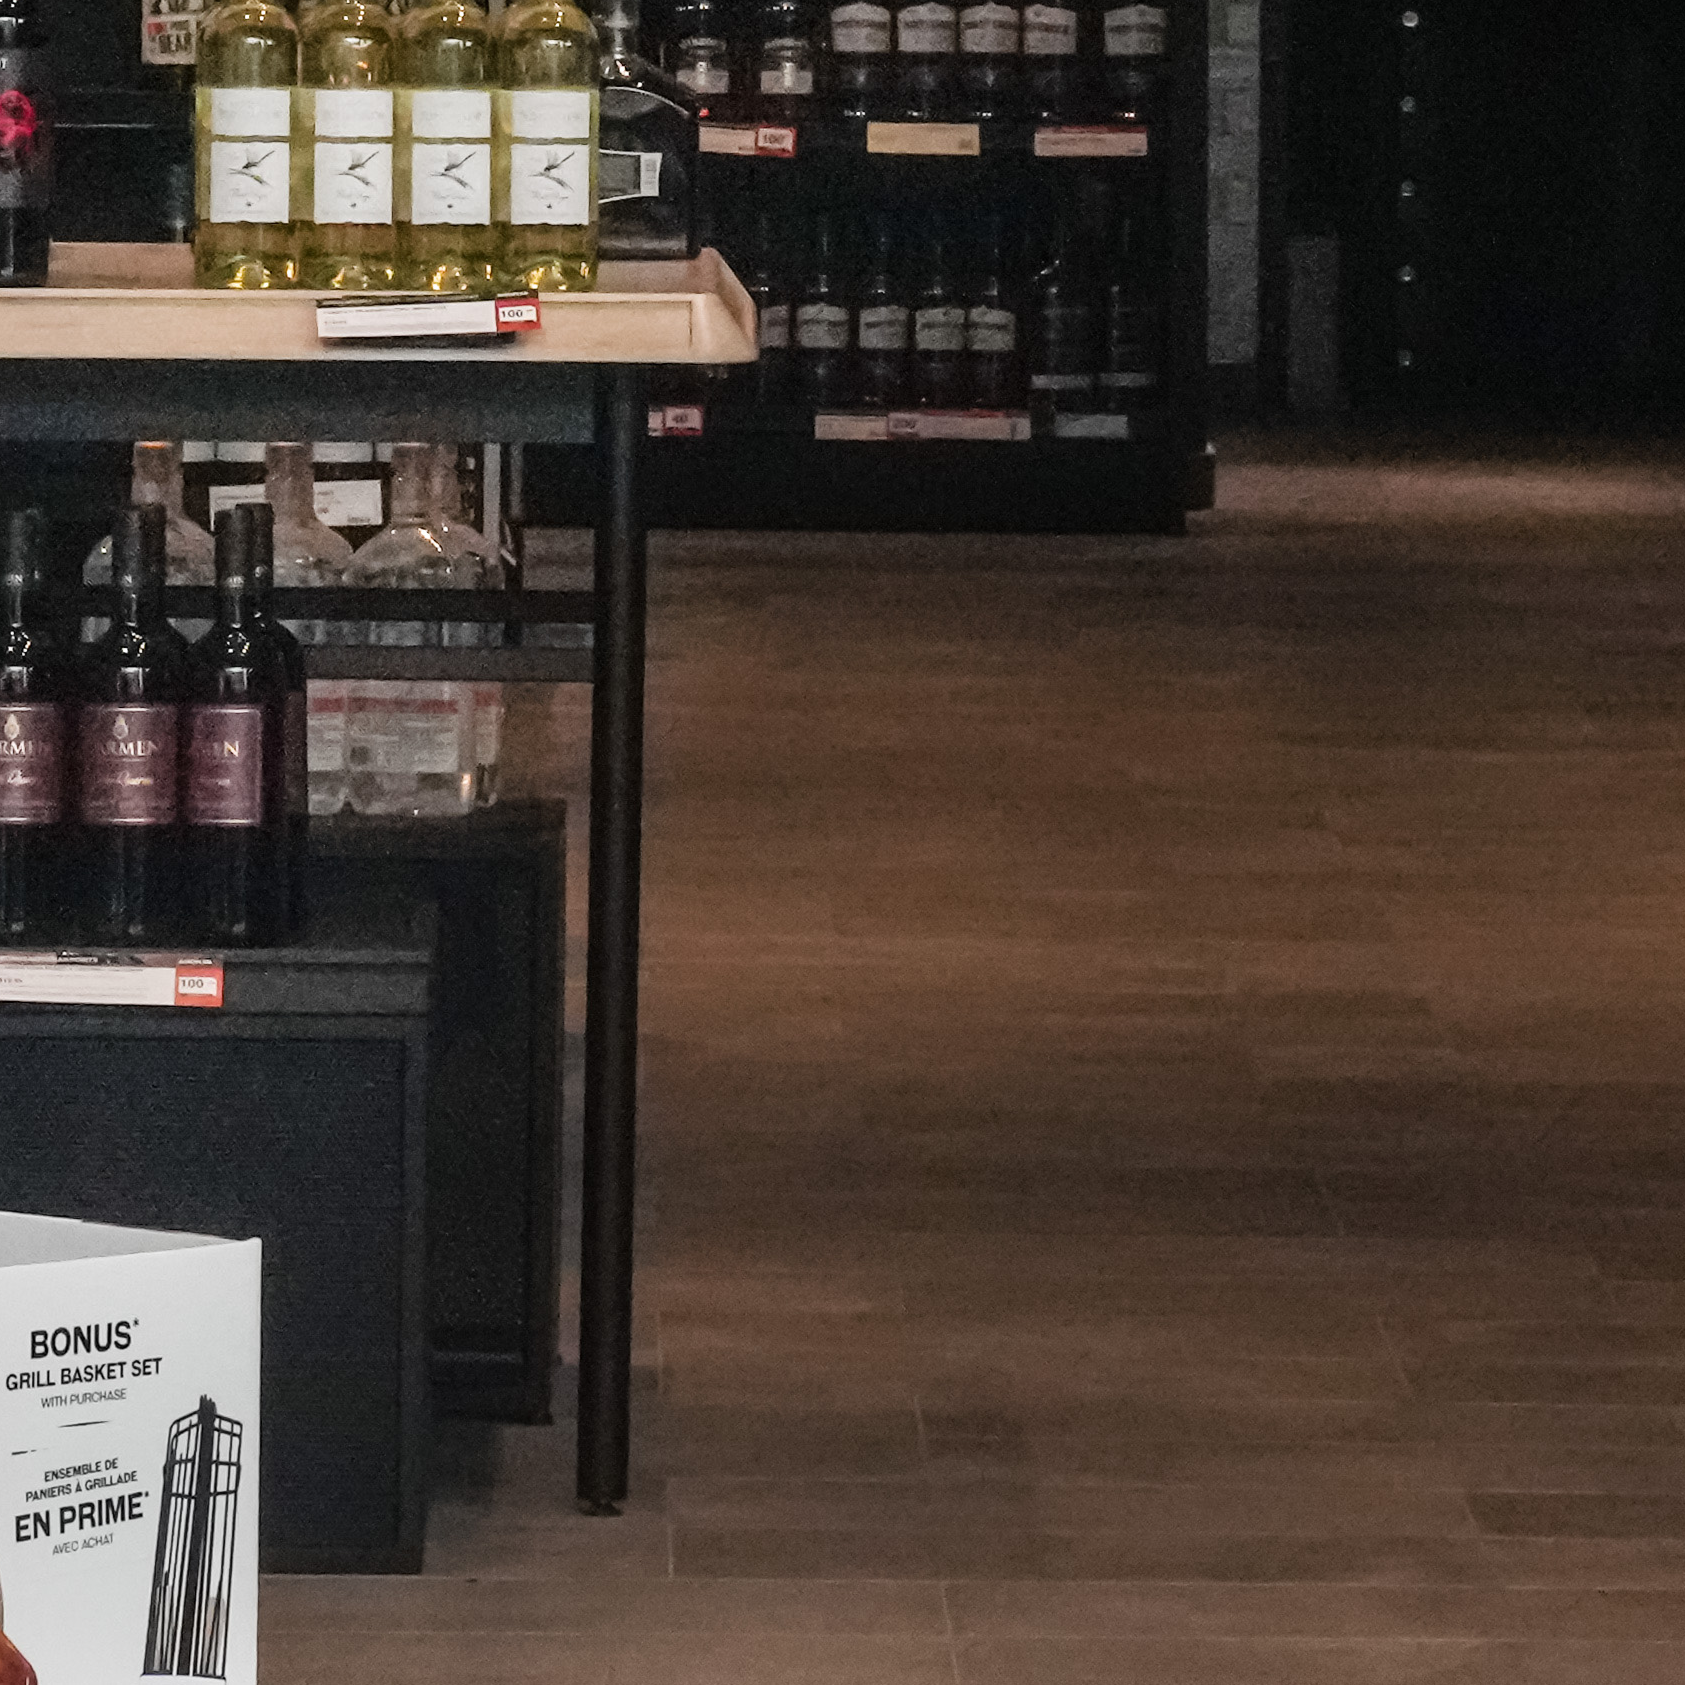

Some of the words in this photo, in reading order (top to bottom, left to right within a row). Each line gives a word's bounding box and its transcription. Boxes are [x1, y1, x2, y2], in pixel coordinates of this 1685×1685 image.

[180, 978, 204, 988] 100
[5, 1370, 56, 1391] GRILL
[61, 1361, 127, 1385] BASKET
[131, 1357, 163, 1377] SET
[41, 1395, 68, 1409] WITH
[69, 1388, 127, 1405] PURCHASE
[44, 1461, 102, 1483] ENSEMBLE
[104, 1457, 119, 1470] DE
[25, 1483, 72, 1502] PANIERS
[75, 1478, 83, 1493] À
[84, 1470, 138, 1491] GRILLADE
[15, 1510, 51, 1543] EN
[52, 1540, 79, 1556] AVEC
[81, 1533, 114, 1549] ACHAT
